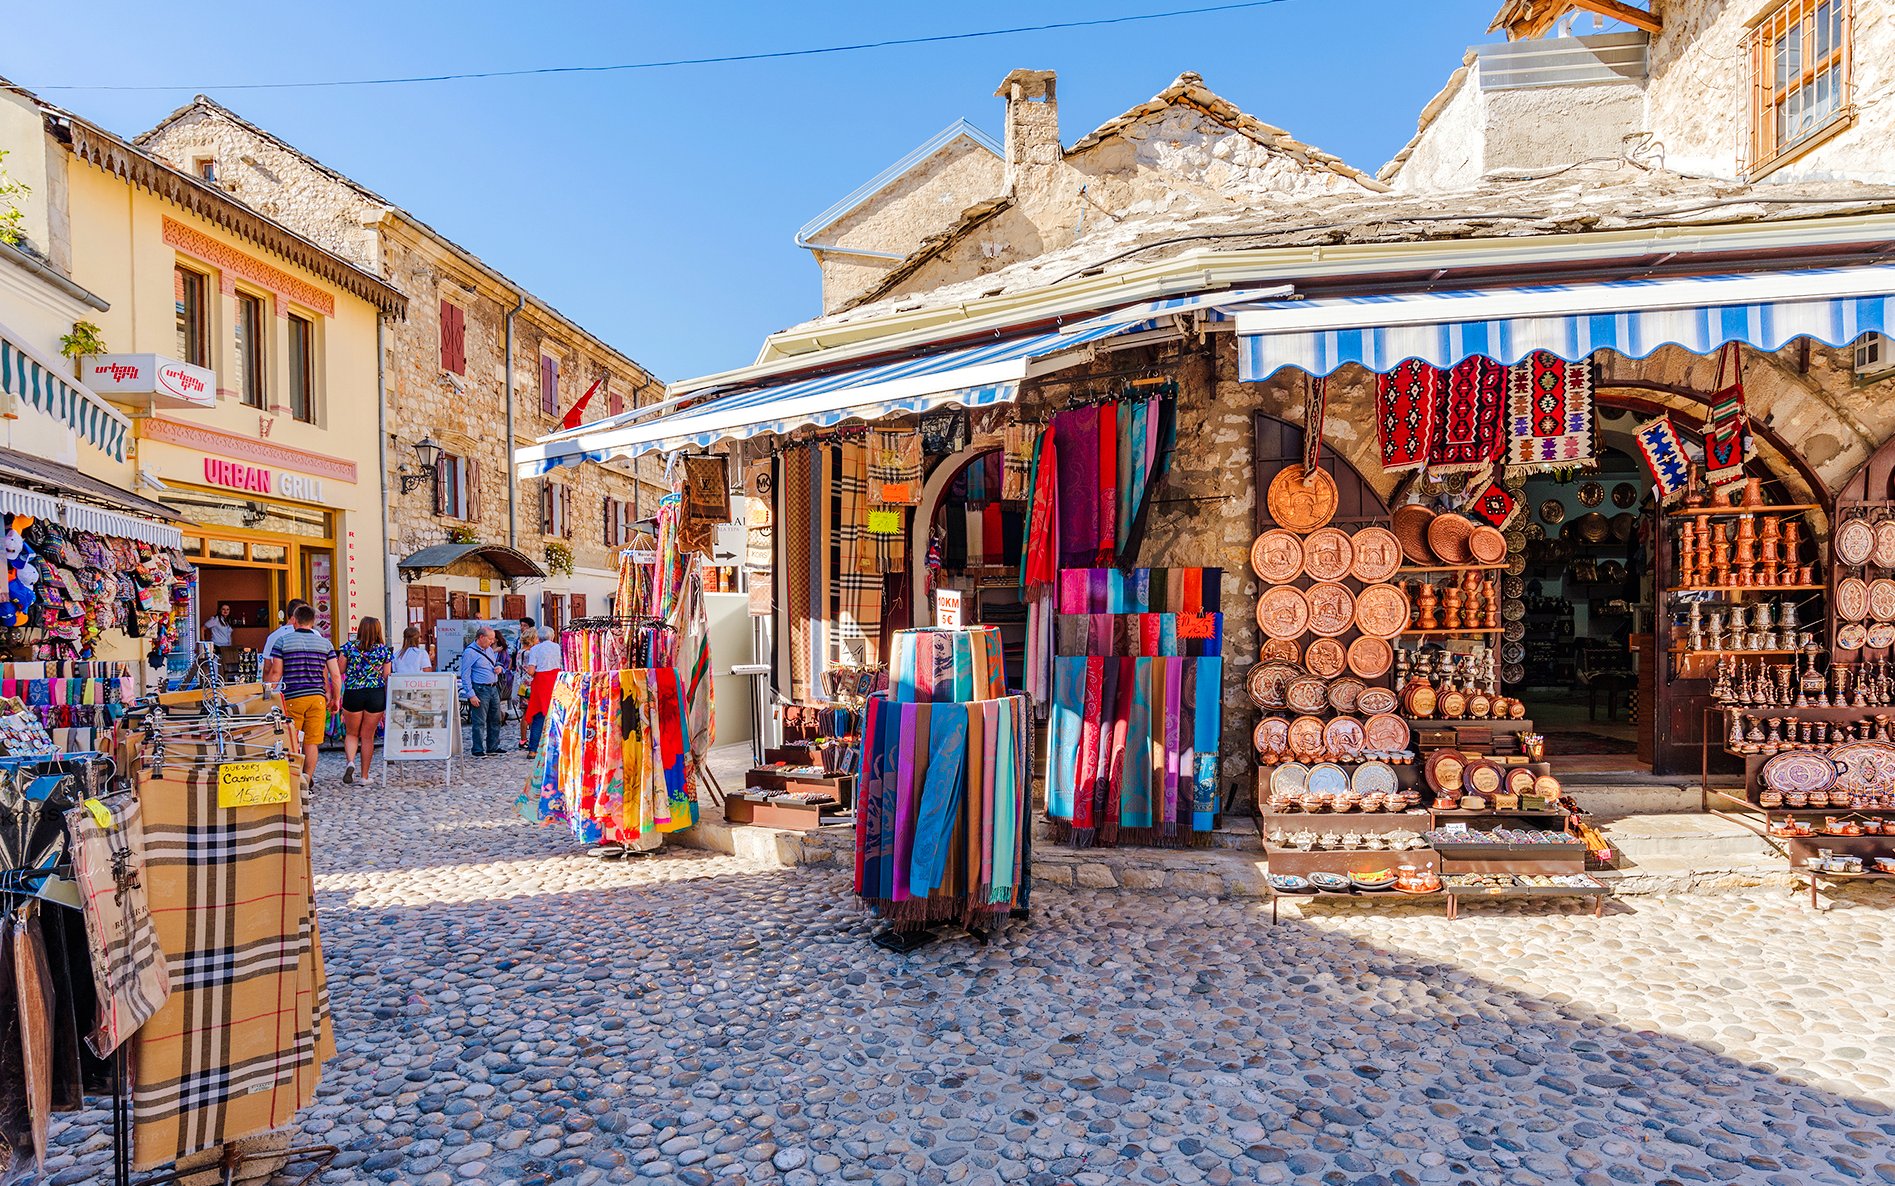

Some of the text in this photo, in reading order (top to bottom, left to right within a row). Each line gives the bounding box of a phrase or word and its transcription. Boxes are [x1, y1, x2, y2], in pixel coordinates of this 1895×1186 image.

[95, 362, 136, 373] urban
[166, 369, 199, 385] urban
[180, 381, 204, 392] grill
[204, 457, 325, 503] URBAN GRILL
[348, 531, 358, 632] RESTAURAN
[938, 596, 960, 608] 10KM
